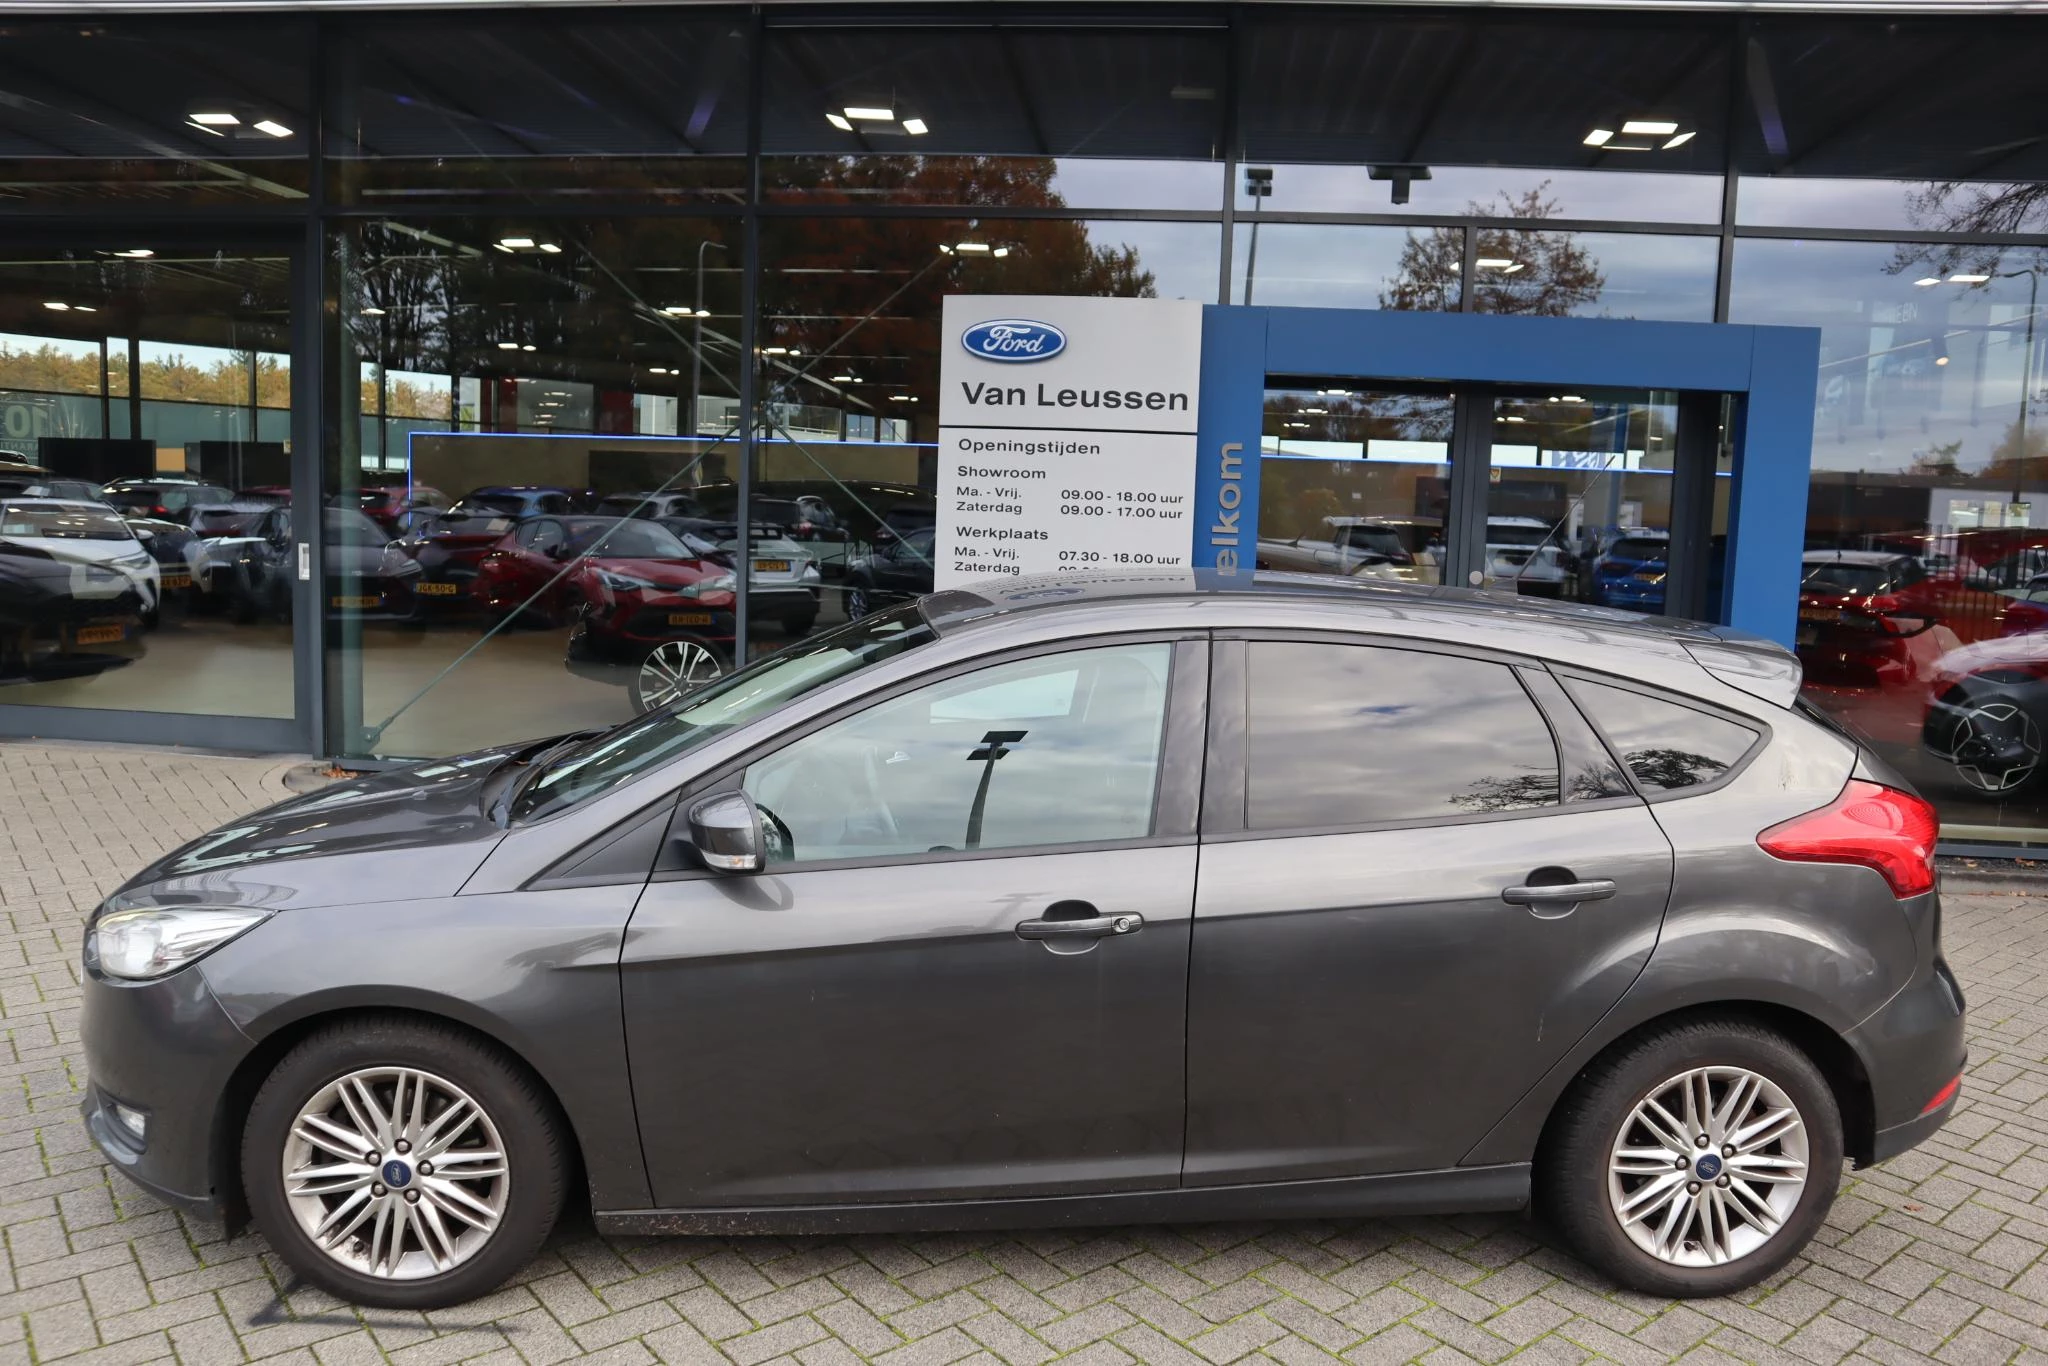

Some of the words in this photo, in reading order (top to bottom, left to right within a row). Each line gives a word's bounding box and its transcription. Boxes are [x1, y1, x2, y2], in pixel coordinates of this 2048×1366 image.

[983, 325, 1046, 352] Ford
[961, 382, 1026, 406] Van
[1037, 383, 1188, 411] Leussen
[958, 438, 1101, 456] Openingstijden
[957, 465, 1046, 479] Showroom
[956, 486, 983, 497] Ma.
[995, 487, 1022, 500] Vrij.
[1061, 489, 1104, 501] 09.00
[1117, 491, 1157, 503] 18.00
[1161, 495, 1184, 504] uur
[956, 501, 1022, 516] Zaterdag
[1060, 504, 1104, 516] 09.00
[1117, 506, 1156, 518] 17.00
[1159, 510, 1183, 519] uur
[956, 526, 1048, 541] Werkplaats
[954, 546, 981, 557] Ma.
[993, 548, 1020, 561] Vrij.
[1058, 550, 1100, 562] 07.30
[1113, 552, 1154, 564] 18.00
[1157, 556, 1181, 565] uur
[954, 561, 1020, 576] Zaterdag
